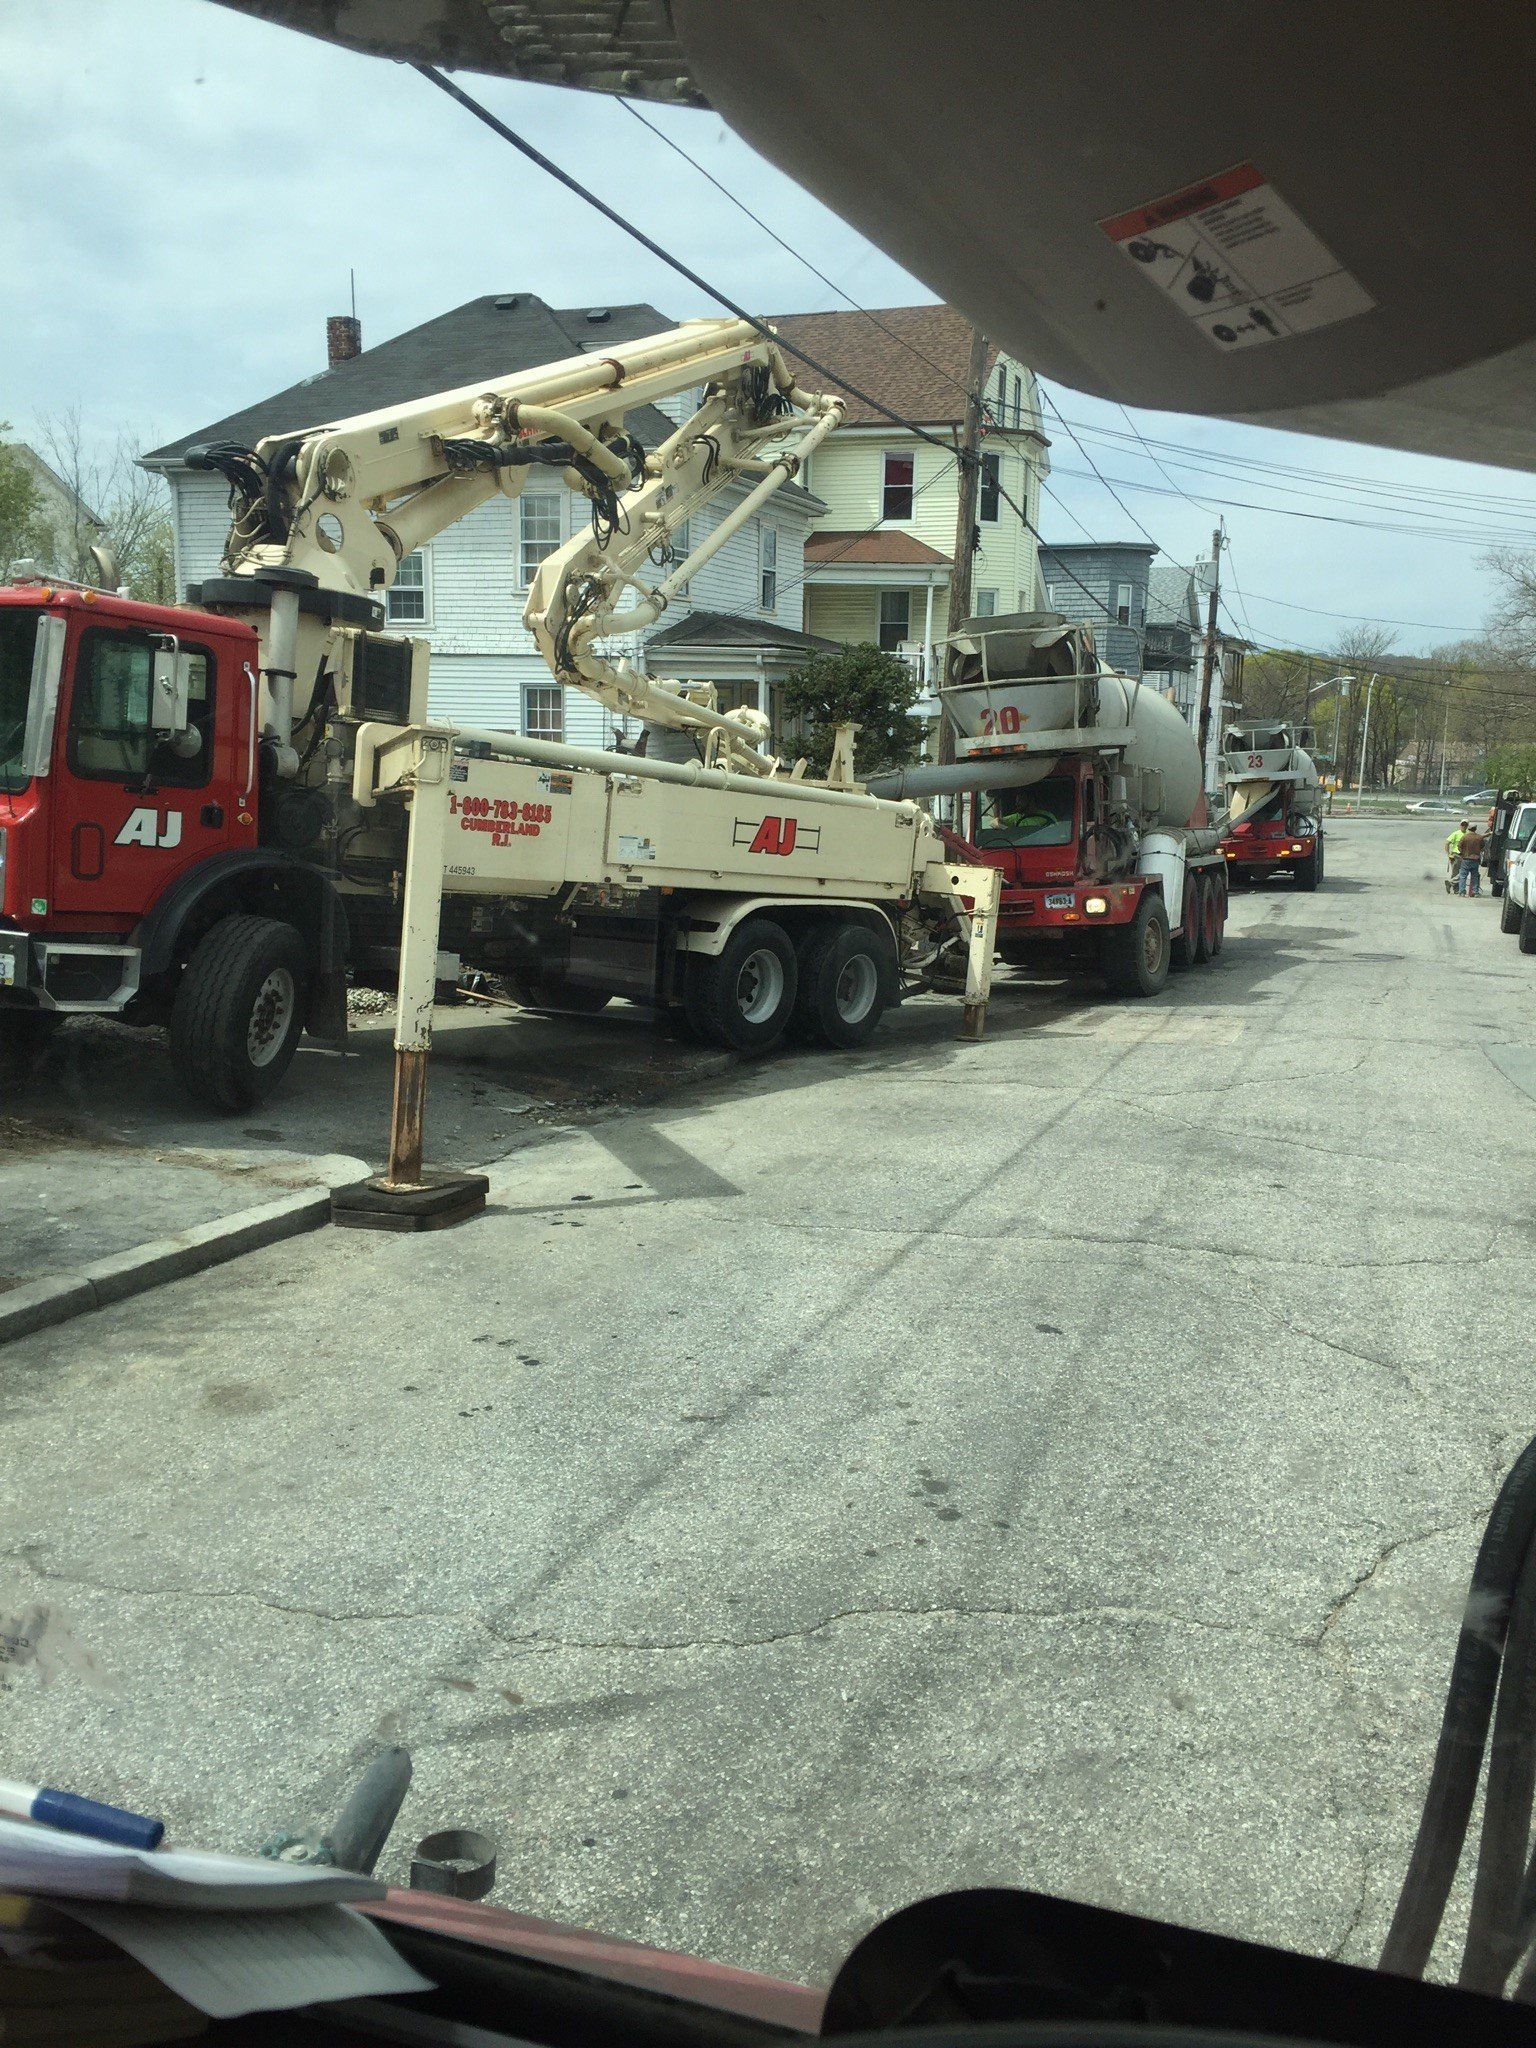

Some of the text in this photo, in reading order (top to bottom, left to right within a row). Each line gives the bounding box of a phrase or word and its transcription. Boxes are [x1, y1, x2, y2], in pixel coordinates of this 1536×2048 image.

[979, 706, 1020, 735] 20
[1247, 754, 1263, 768] 23
[113, 807, 182, 848] AJ
[460, 817, 541, 837] CUMBERLAND
[748, 816, 798, 857] AJ
[449, 866, 476, 876] 445943
